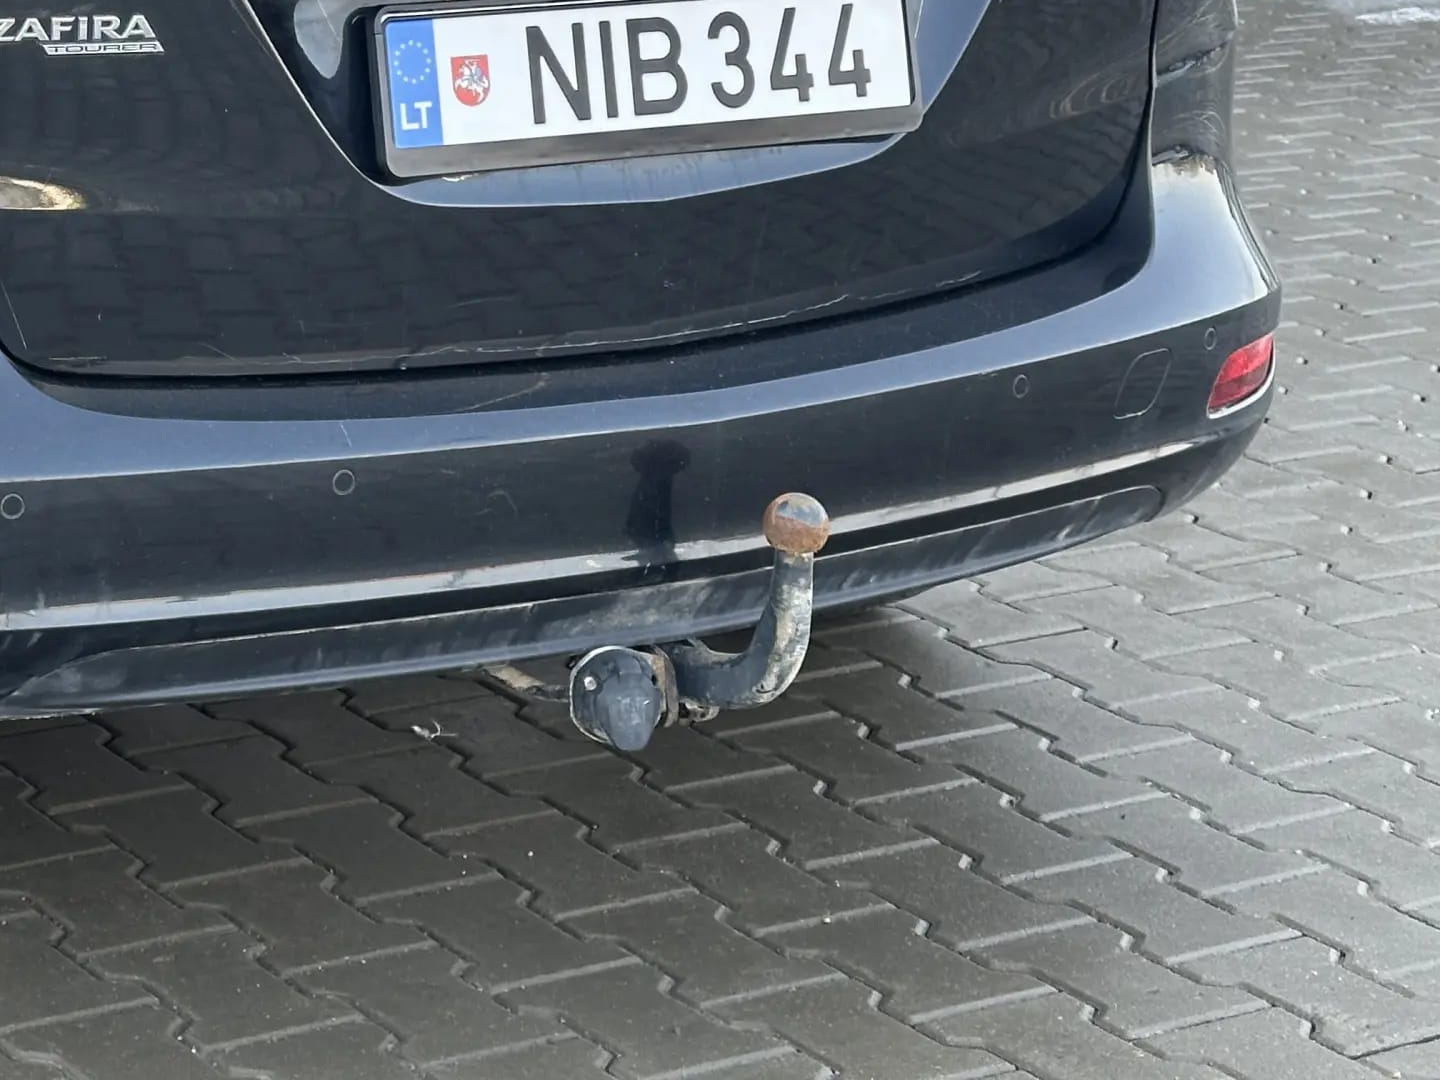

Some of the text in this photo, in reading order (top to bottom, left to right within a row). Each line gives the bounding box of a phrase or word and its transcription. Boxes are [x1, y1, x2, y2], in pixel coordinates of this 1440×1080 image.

[47, 43, 159, 54] TOURER
[526, 3, 872, 124] NIB 344
[400, 100, 433, 130] LT
